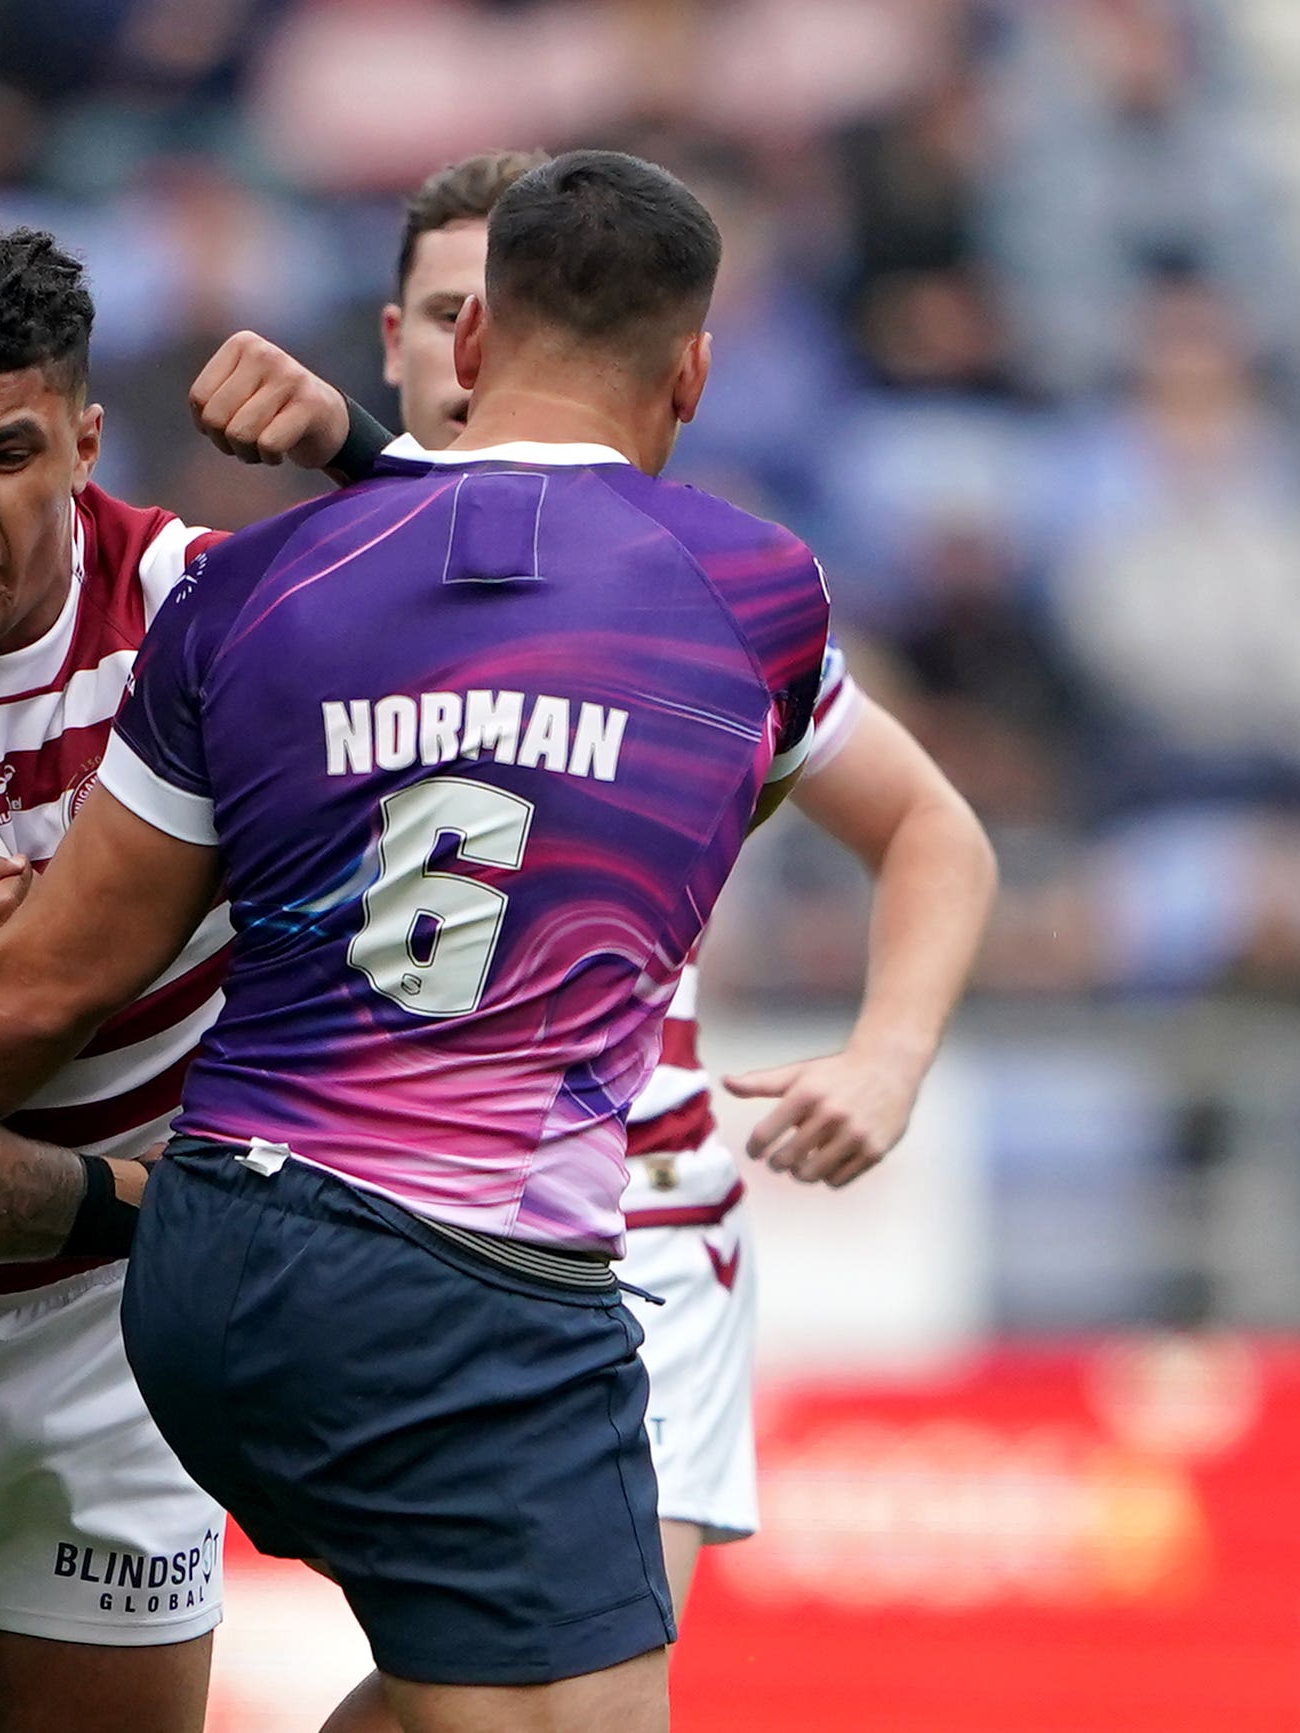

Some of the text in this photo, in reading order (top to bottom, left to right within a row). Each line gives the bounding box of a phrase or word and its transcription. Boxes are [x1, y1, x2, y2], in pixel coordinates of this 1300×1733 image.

[322, 690, 629, 782] NORMAN
[347, 776, 535, 1018] 6
[54, 1528, 220, 1589] BLINDSPOT
[99, 1585, 204, 1613] GLOBAL
